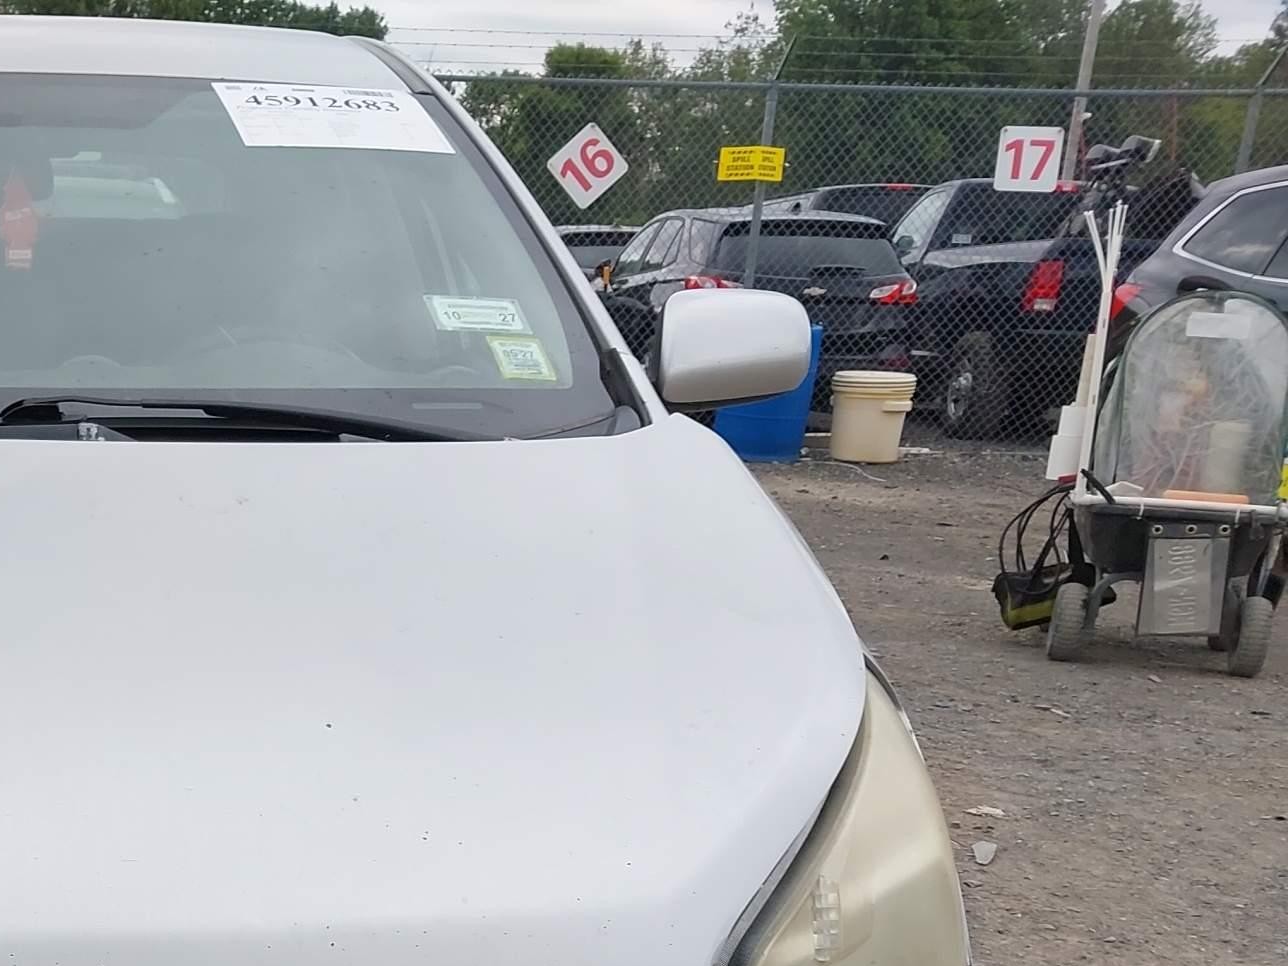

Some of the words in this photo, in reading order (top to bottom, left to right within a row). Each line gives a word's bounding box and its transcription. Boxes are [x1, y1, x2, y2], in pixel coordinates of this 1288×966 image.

[245, 95, 400, 112] 45912683
[560, 138, 614, 192] 16
[1005, 139, 1056, 180] 17
[444, 311, 461, 321] 10
[498, 312, 516, 322] 27
